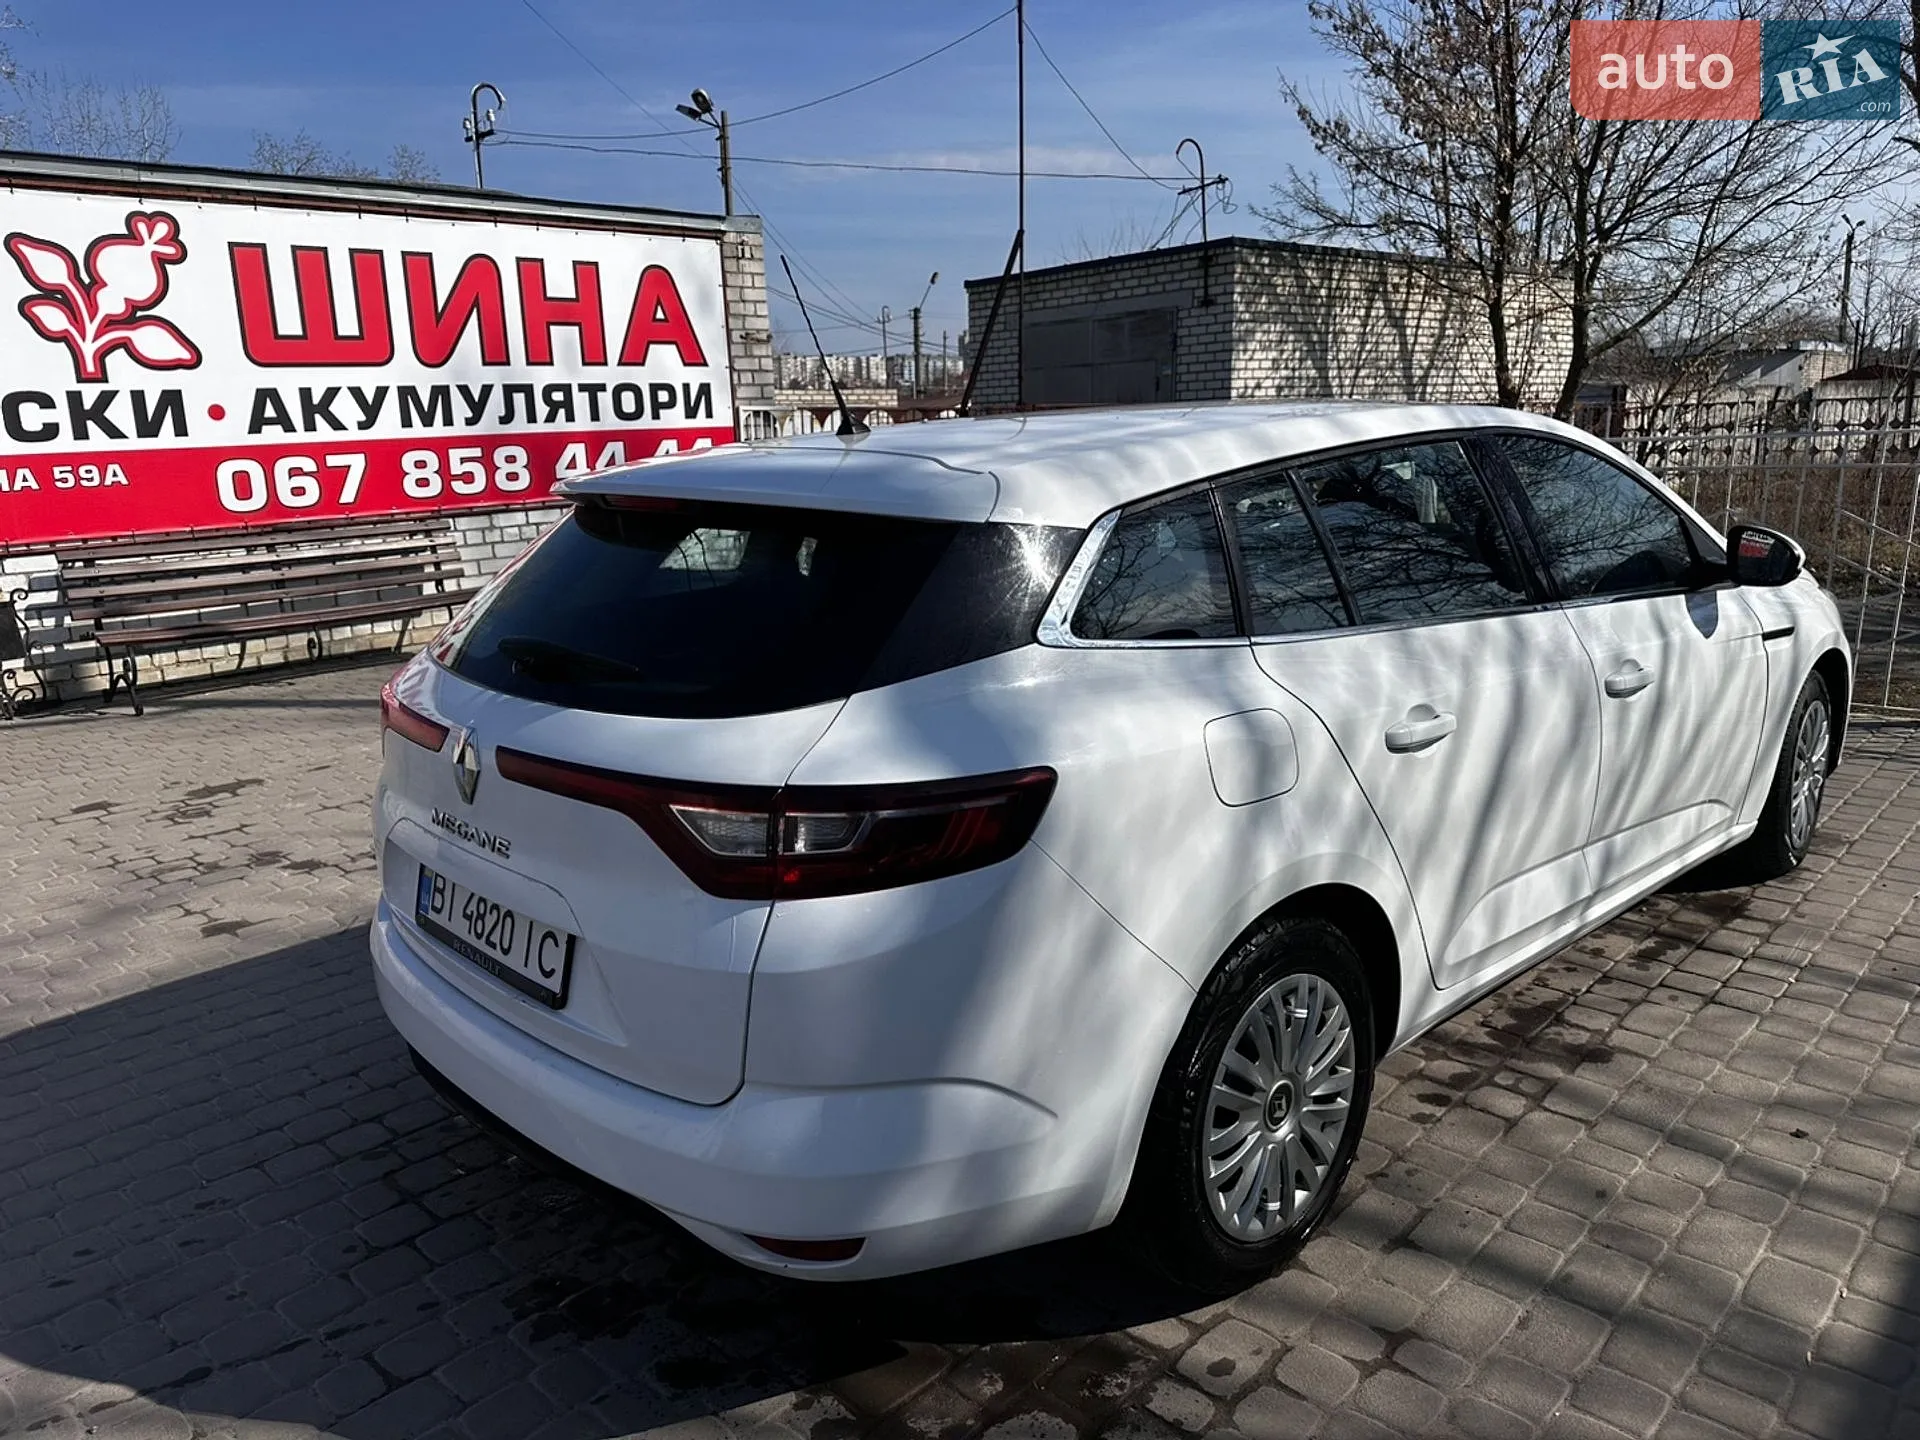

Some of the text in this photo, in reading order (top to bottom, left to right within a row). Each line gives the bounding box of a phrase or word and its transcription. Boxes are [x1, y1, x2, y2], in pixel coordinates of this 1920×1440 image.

[227, 241, 708, 368] ШИНА
[247, 382, 714, 435] АКУМУЛЯТОРИ
[215, 452, 368, 513] 067
[401, 445, 531, 499] 858
[431, 807, 512, 859] MEGANE
[461, 891, 515, 956] 4820
